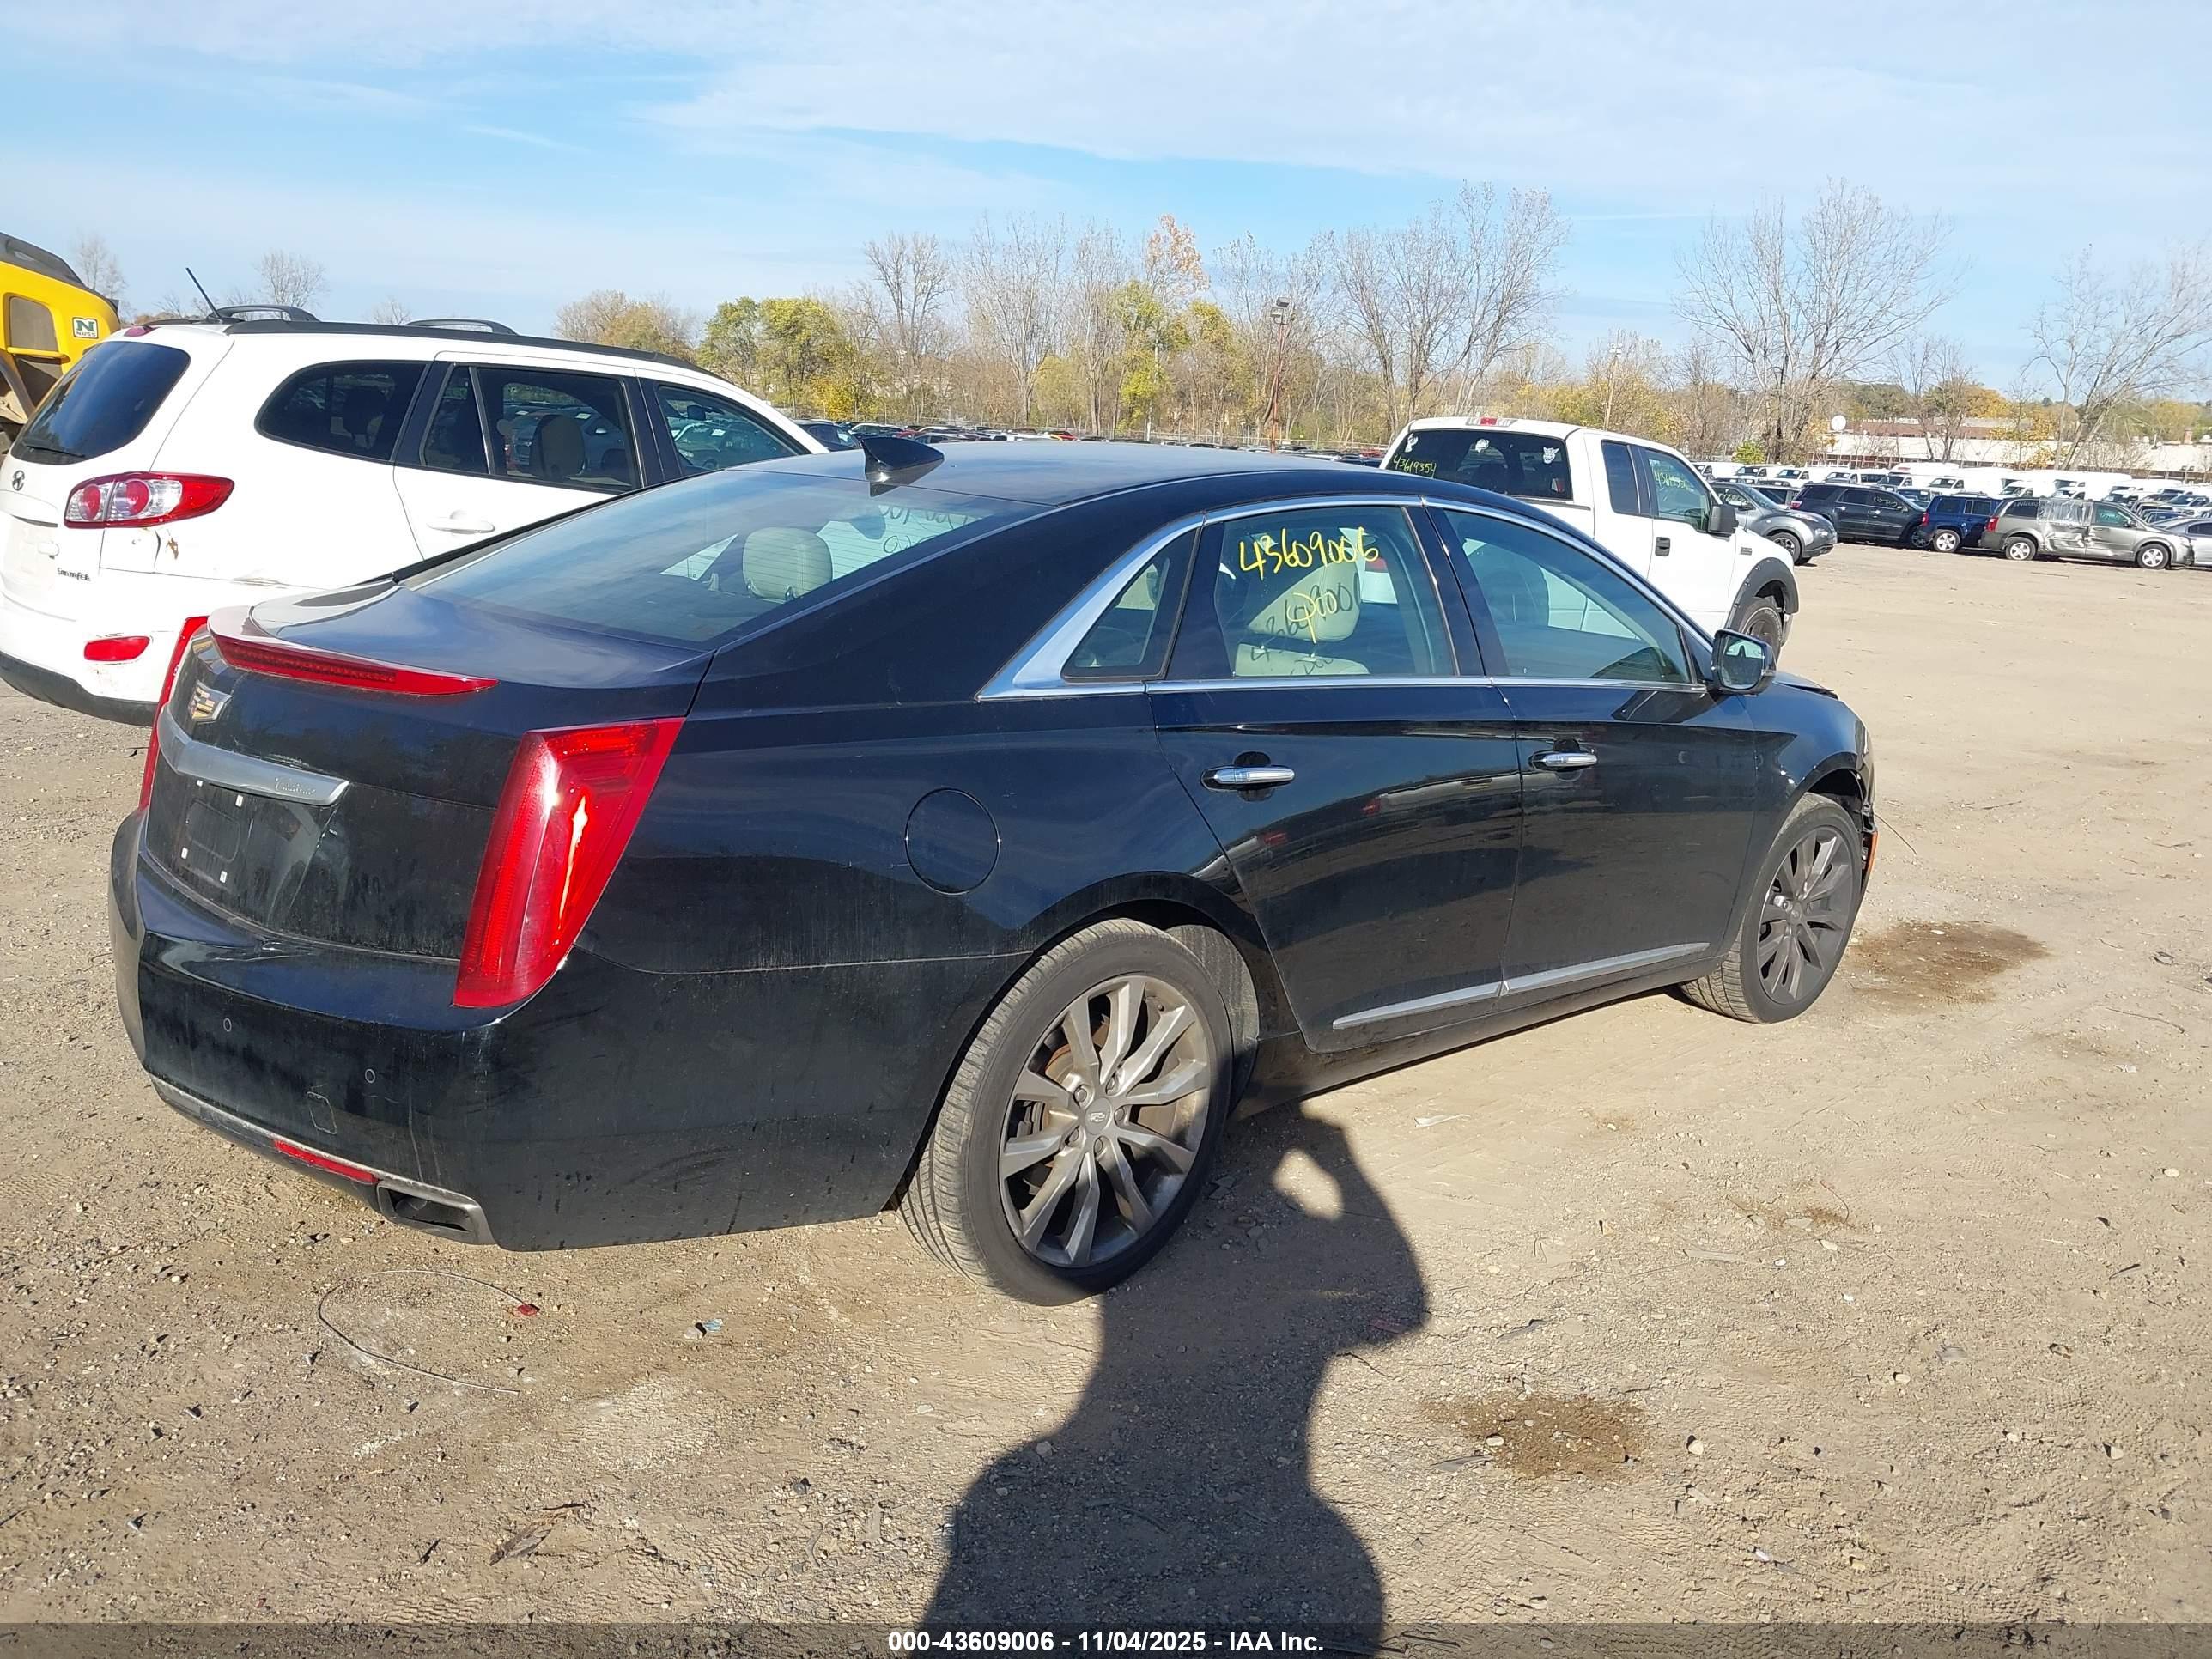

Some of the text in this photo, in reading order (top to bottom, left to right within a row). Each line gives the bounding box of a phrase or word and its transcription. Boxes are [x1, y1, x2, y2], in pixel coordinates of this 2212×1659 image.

[75, 320, 95, 332] N
[1393, 453, 1437, 479] 43619354
[1239, 526, 1379, 581] 43609006
